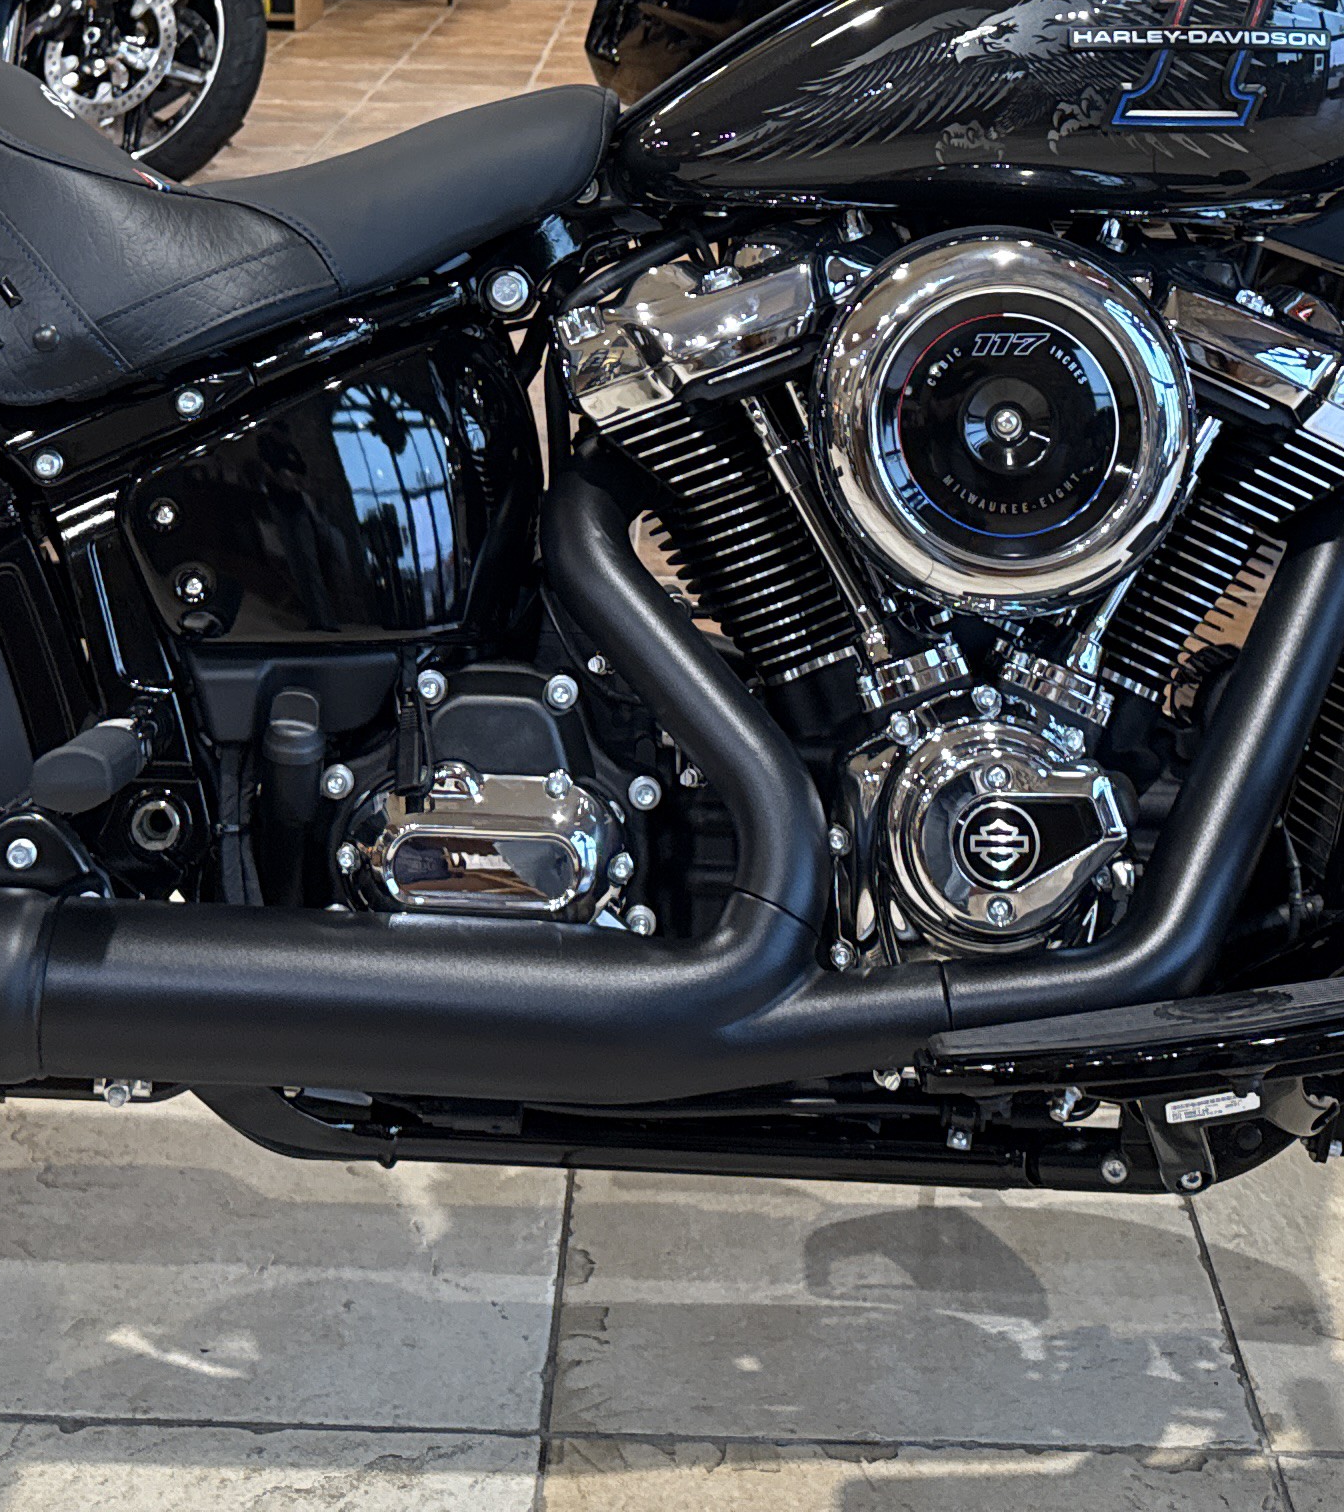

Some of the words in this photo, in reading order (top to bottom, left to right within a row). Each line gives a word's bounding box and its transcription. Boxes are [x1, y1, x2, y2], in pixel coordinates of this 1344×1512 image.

[1072, 29, 1327, 47] HARLEY-DAVIDSON
[926, 347, 962, 387] CUBIC
[971, 332, 1051, 357] 117
[1049, 345, 1088, 386] INCHES
[941, 473, 1081, 515] MILWAUKEE-EIGHT
